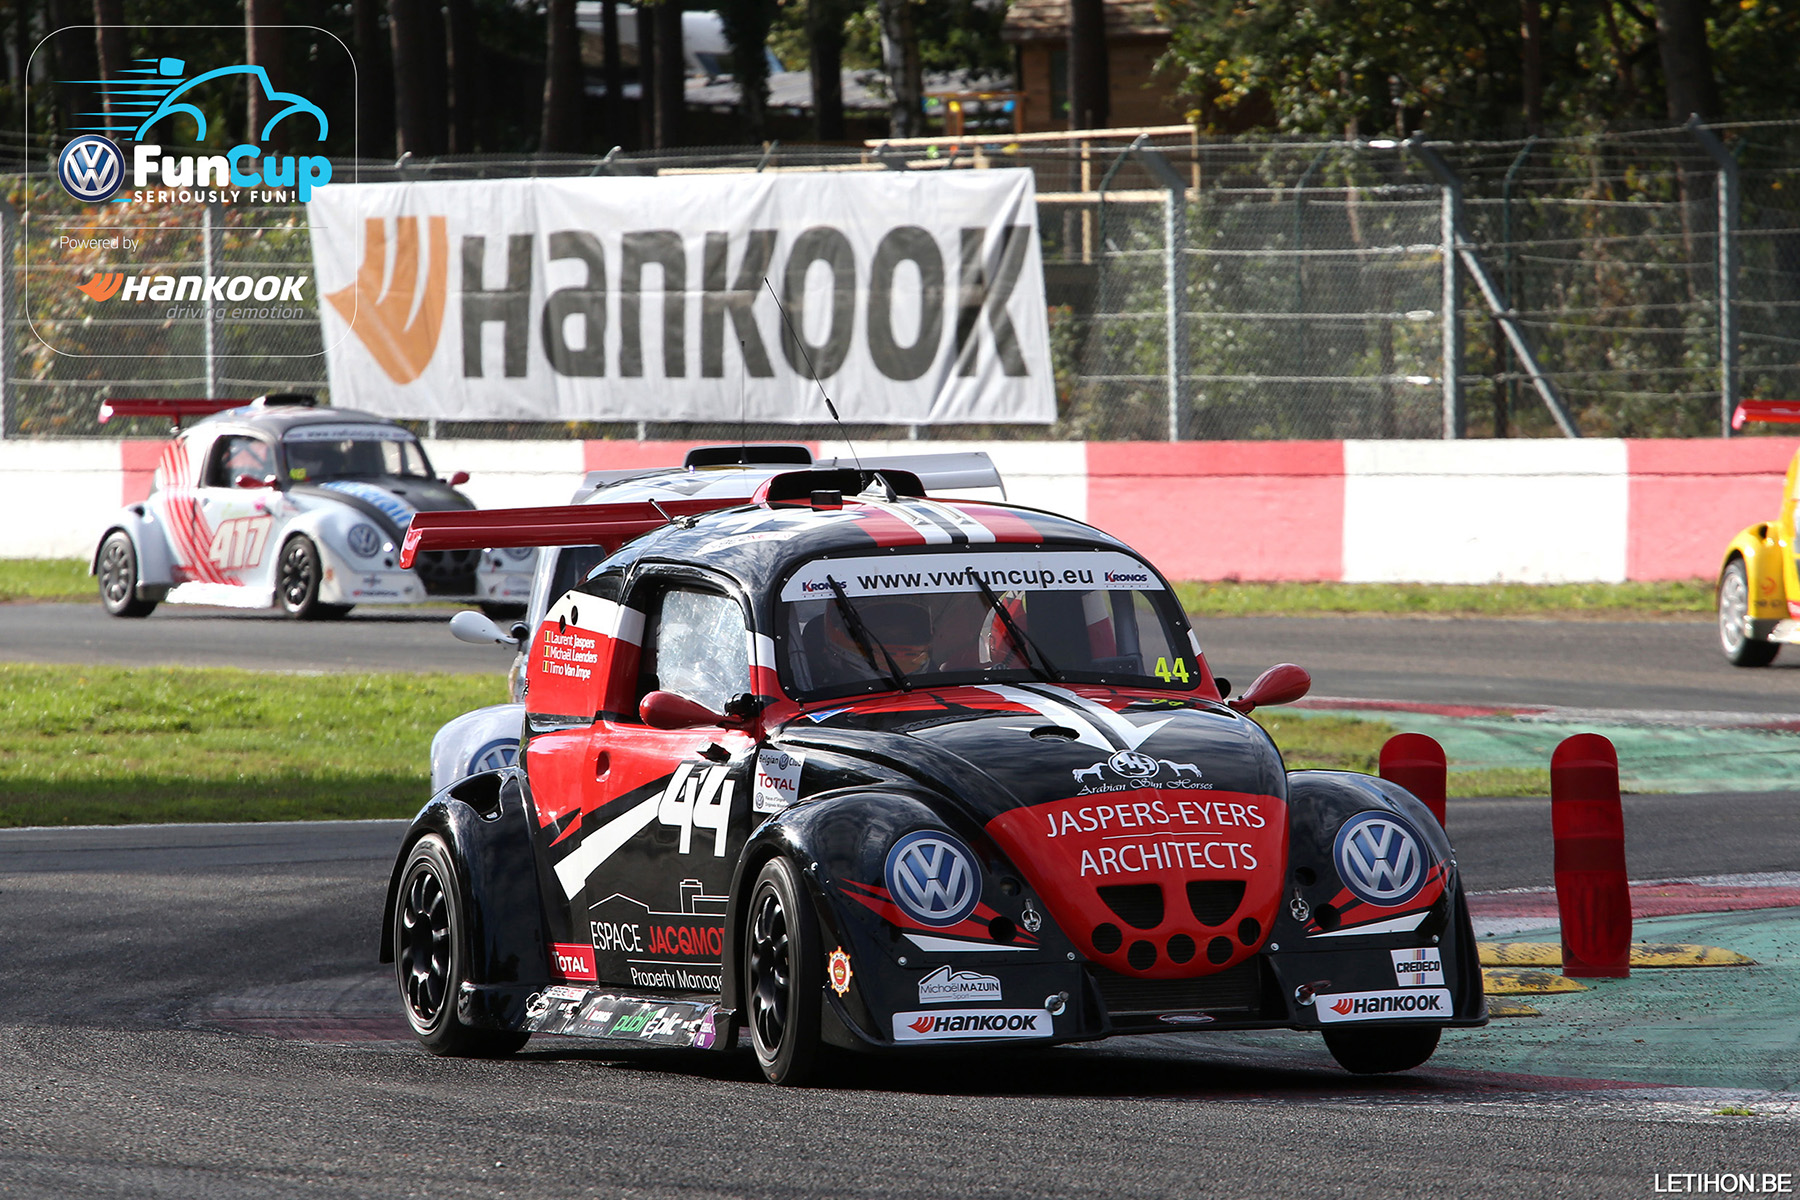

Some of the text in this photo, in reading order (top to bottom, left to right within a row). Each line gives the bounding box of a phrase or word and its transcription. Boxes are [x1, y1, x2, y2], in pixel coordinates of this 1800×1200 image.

[208, 517, 272, 571] 417
[857, 567, 1094, 590] www.vwfuncup.eu
[1104, 569, 1147, 582] KRONOS
[551, 631, 595, 651] Laurent Jaspers
[572, 649, 598, 664] Leenders
[549, 661, 591, 681] Timo Van Impe
[1154, 657, 1189, 683] 44
[758, 773, 795, 791] TOTAL
[1077, 778, 1213, 796] Arabian Sun Horses
[658, 760, 735, 857] 44
[1047, 800, 1266, 838] JASPERS-EYERS
[1080, 842, 1258, 877] ARCHITECTS
[590, 921, 643, 952] ESPACE
[552, 951, 589, 973] TOTAL
[1396, 960, 1440, 973] CREDECO
[630, 967, 675, 989] Property
